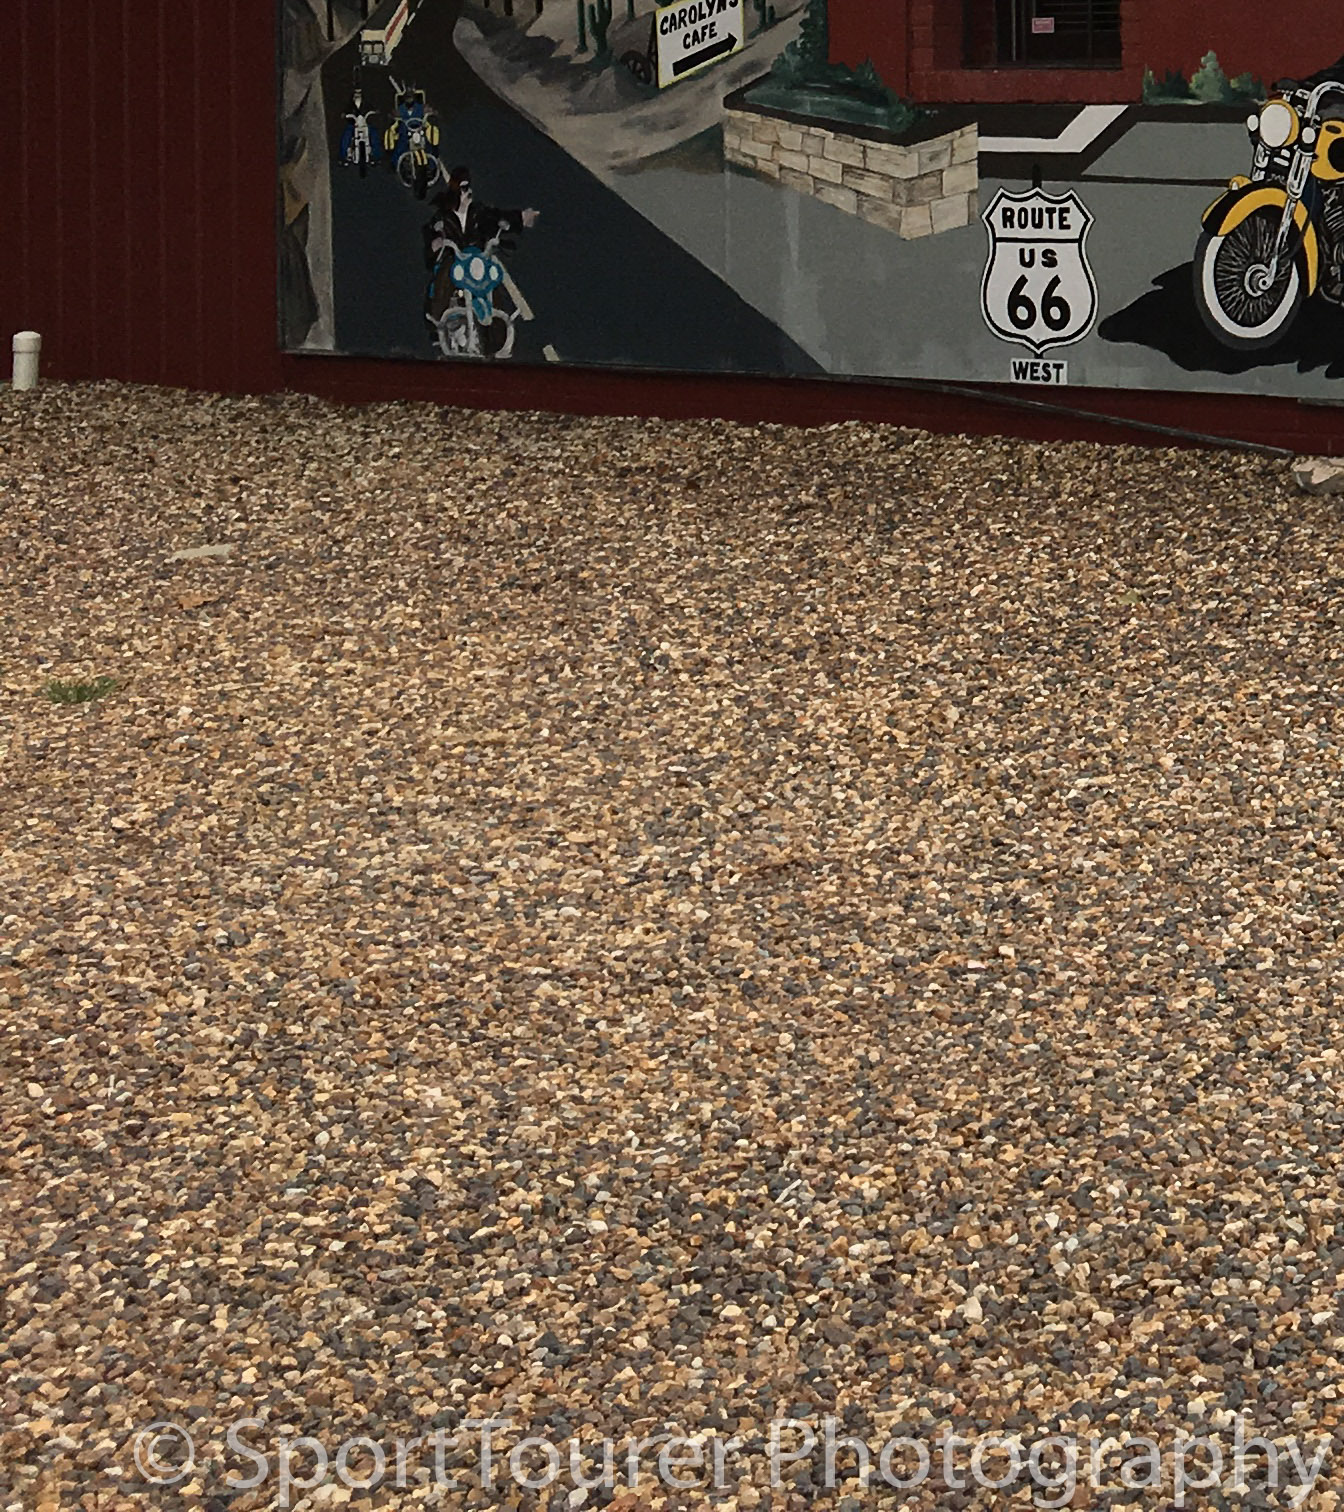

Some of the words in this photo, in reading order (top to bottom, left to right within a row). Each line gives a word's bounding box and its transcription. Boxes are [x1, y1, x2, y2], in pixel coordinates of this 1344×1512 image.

[682, 21, 718, 50] CAFE
[1001, 207, 1071, 230] ROUTE
[1019, 247, 1058, 268] US
[1007, 274, 1071, 331] 66
[1013, 360, 1065, 384] WEST
